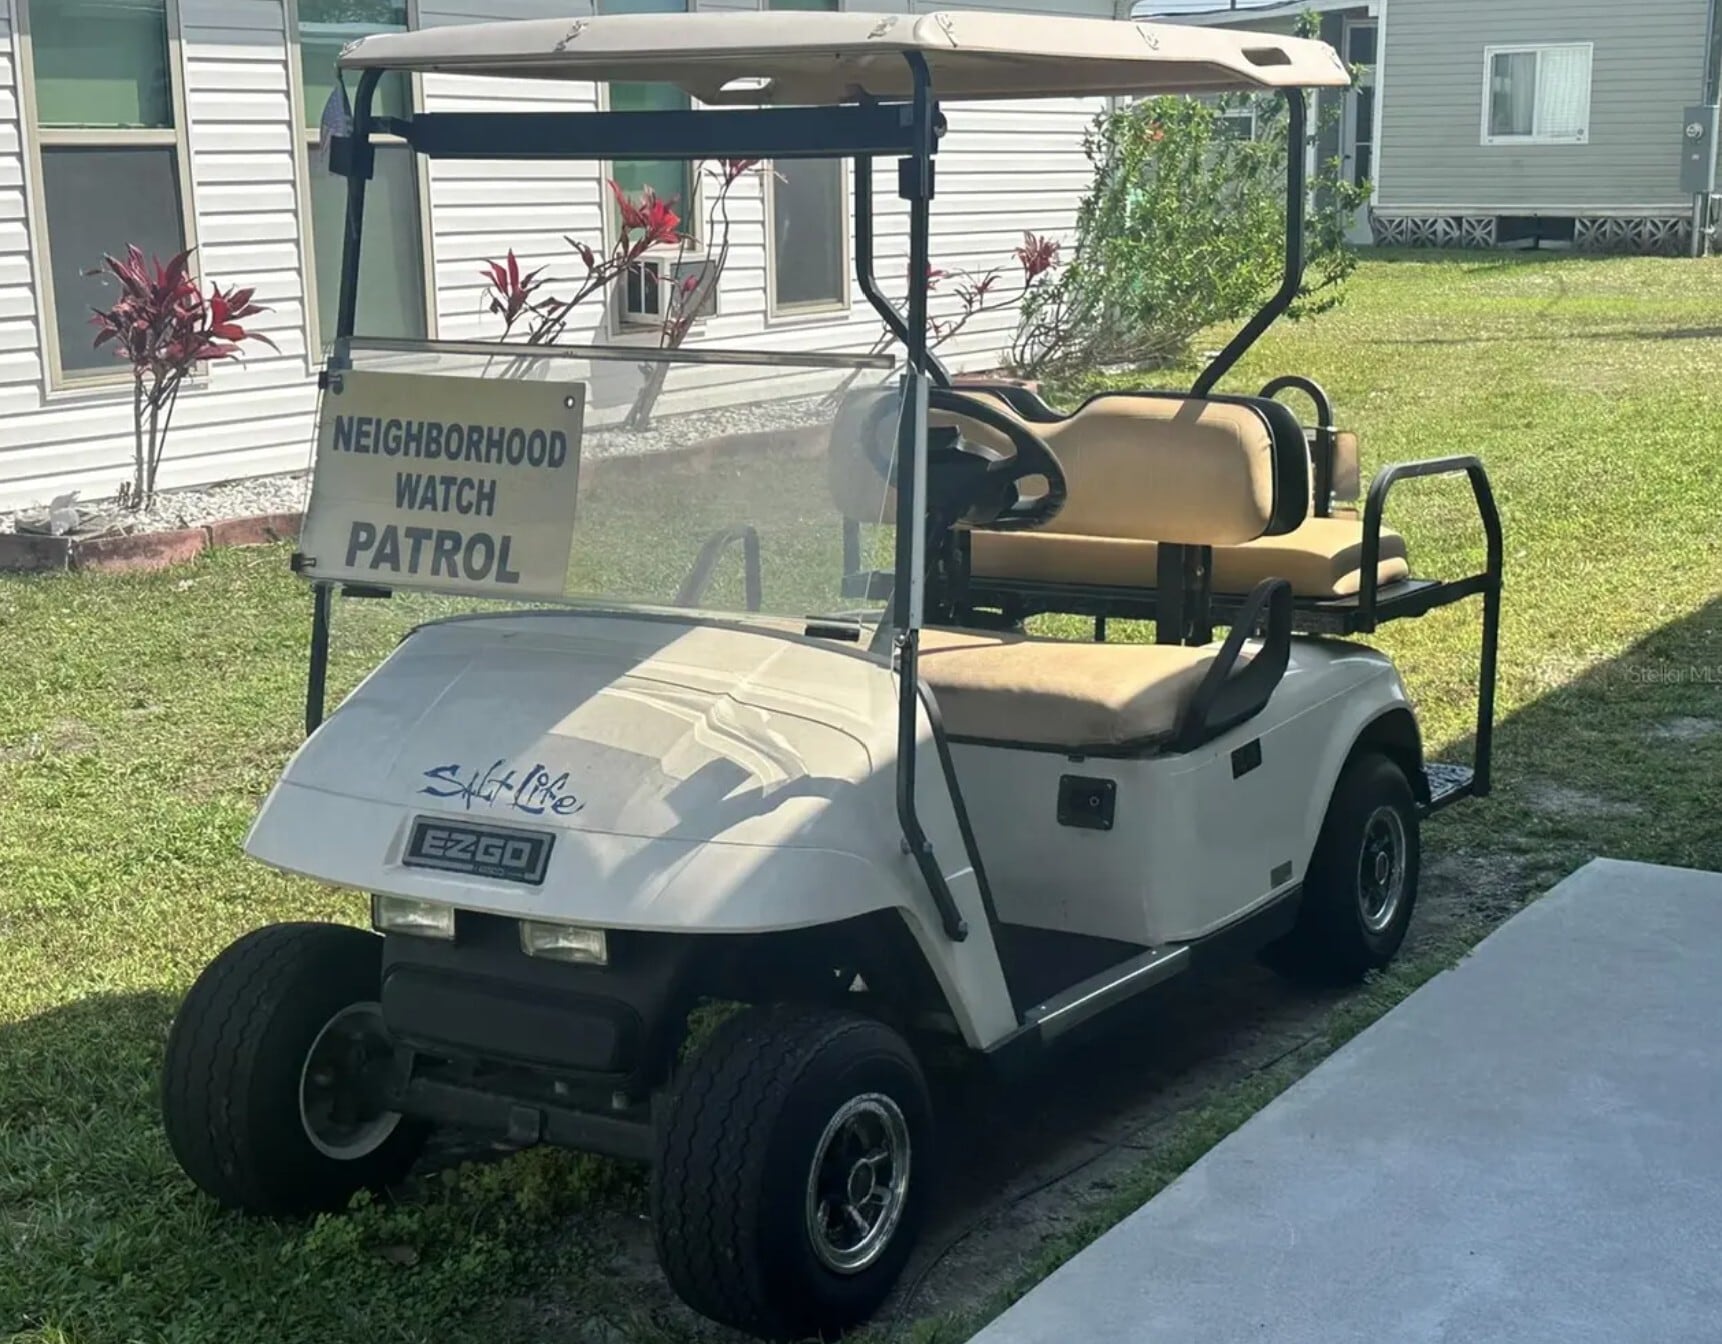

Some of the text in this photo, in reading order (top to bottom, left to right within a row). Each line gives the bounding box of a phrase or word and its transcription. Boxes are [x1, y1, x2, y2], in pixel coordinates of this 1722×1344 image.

[333, 415, 567, 468] NEIGHBORHOOD
[395, 472, 496, 516] WATCH
[345, 521, 520, 583] PATROL
